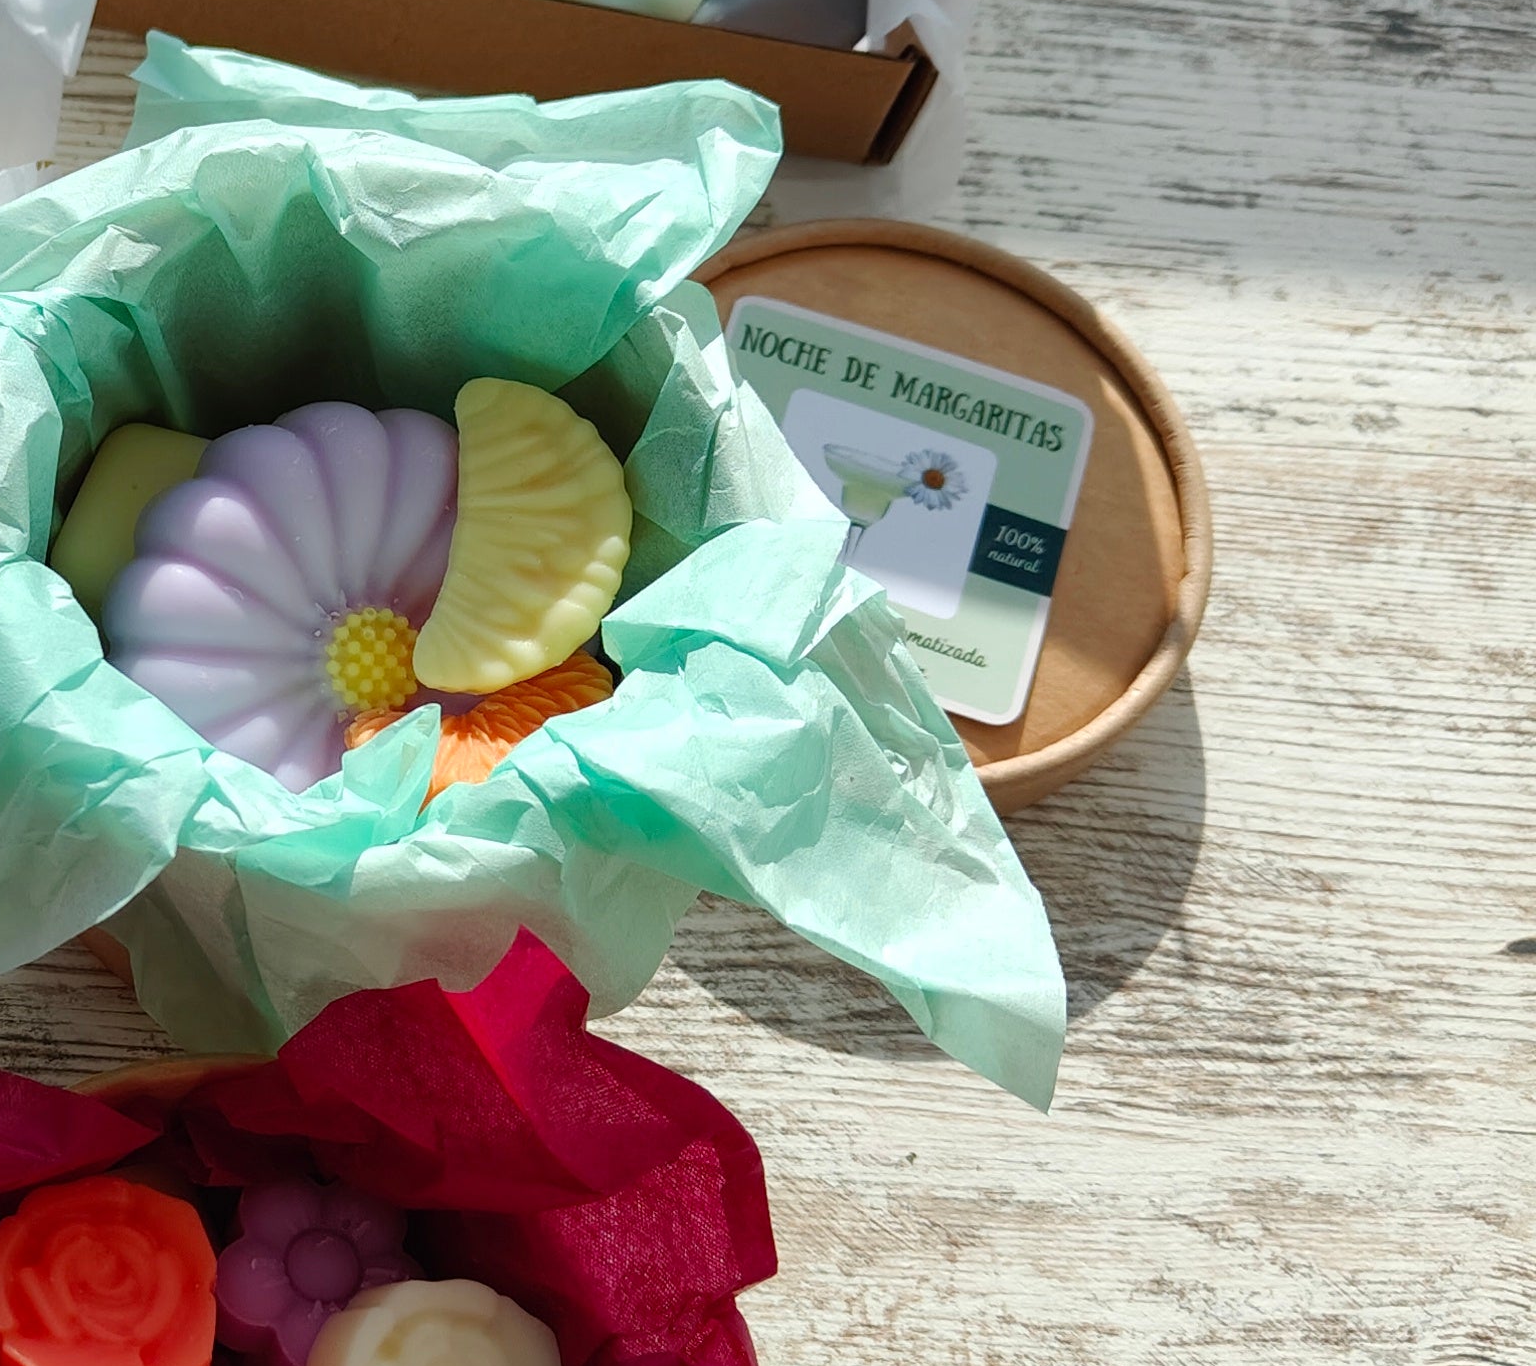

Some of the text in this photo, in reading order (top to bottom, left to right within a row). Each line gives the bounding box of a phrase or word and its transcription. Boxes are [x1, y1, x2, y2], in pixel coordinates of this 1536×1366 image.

[738, 324, 1066, 453] NOCHE DE MARGARITAS
[994, 523, 1047, 555] 100%
[987, 547, 1043, 574] natural
[905, 629, 988, 667] matizada
